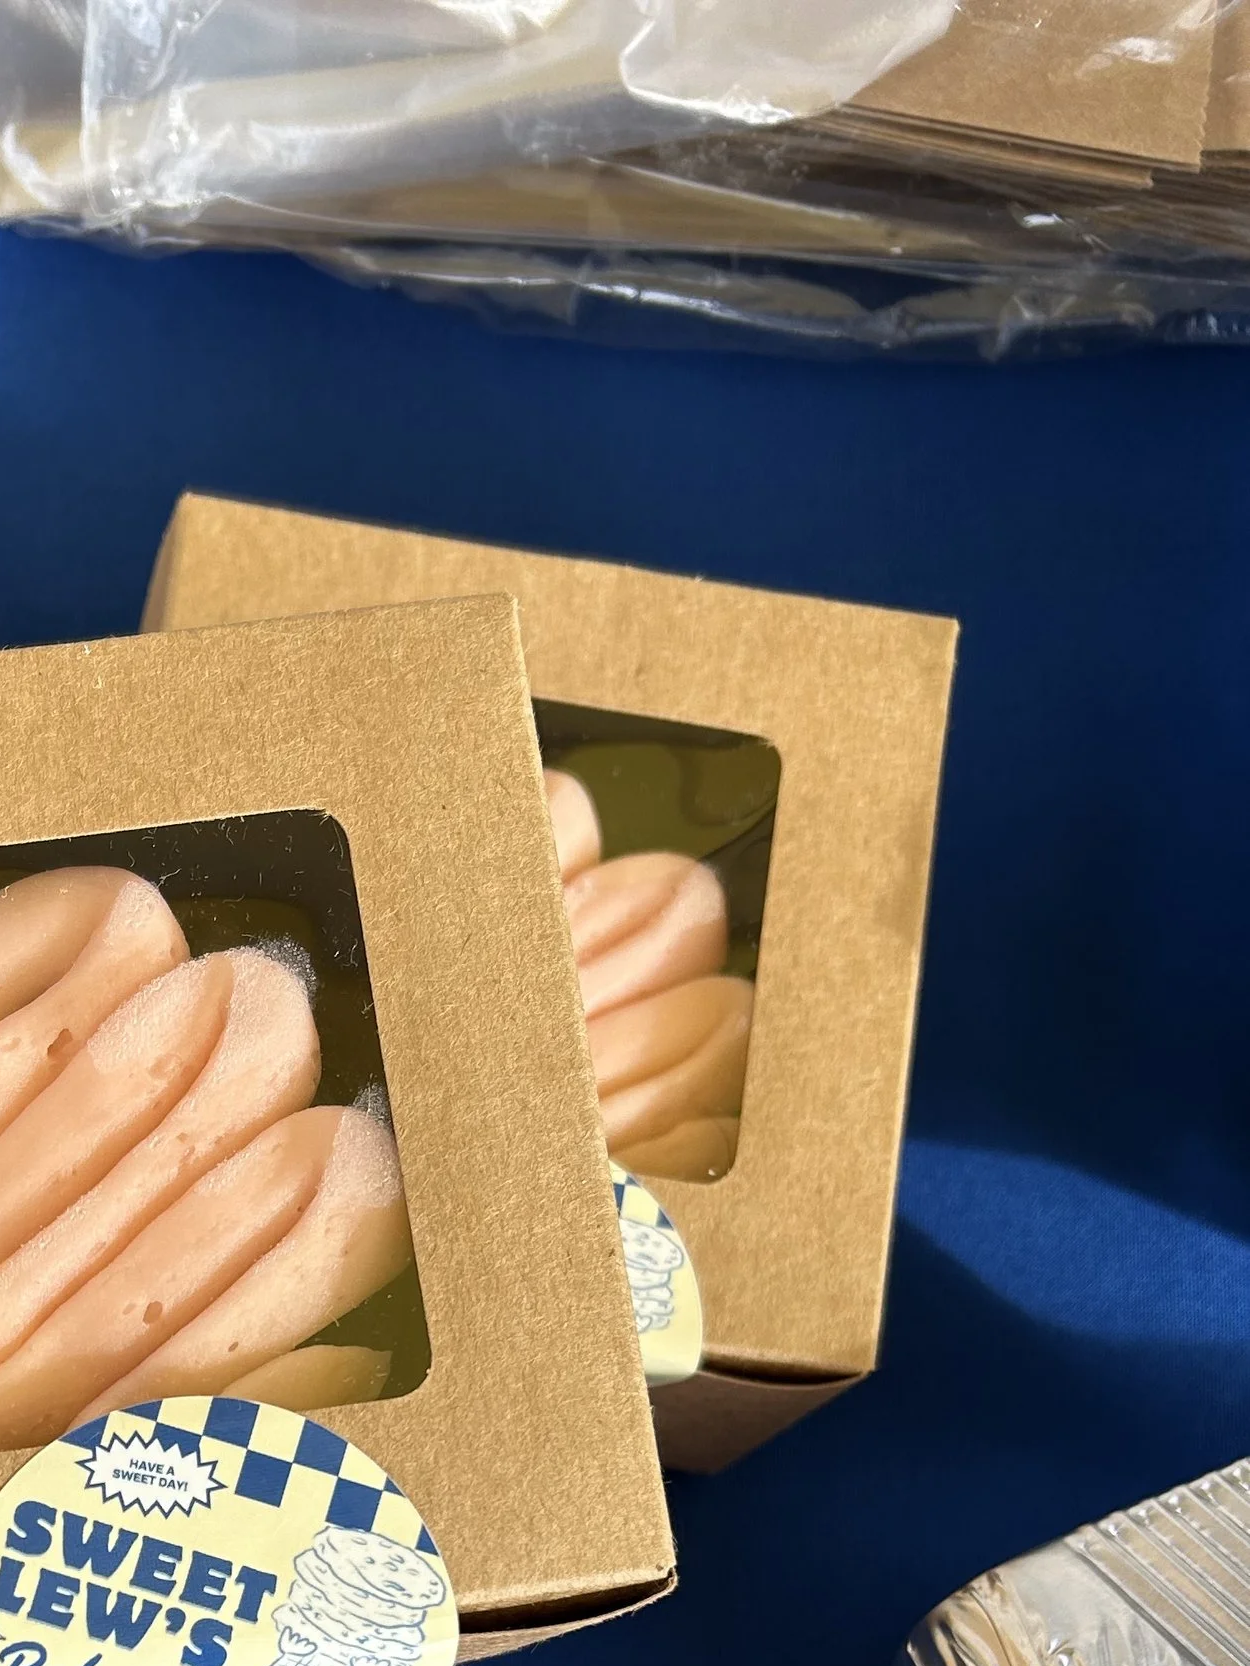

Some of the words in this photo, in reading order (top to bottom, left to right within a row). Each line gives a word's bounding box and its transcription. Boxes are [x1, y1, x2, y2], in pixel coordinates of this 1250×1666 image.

[129, 1458, 164, 1475] HAVE
[166, 1465, 175, 1476] A
[112, 1468, 156, 1485] SWEET
[158, 1477, 189, 1492] DAY!
[5, 1500, 277, 1625] SWEET
